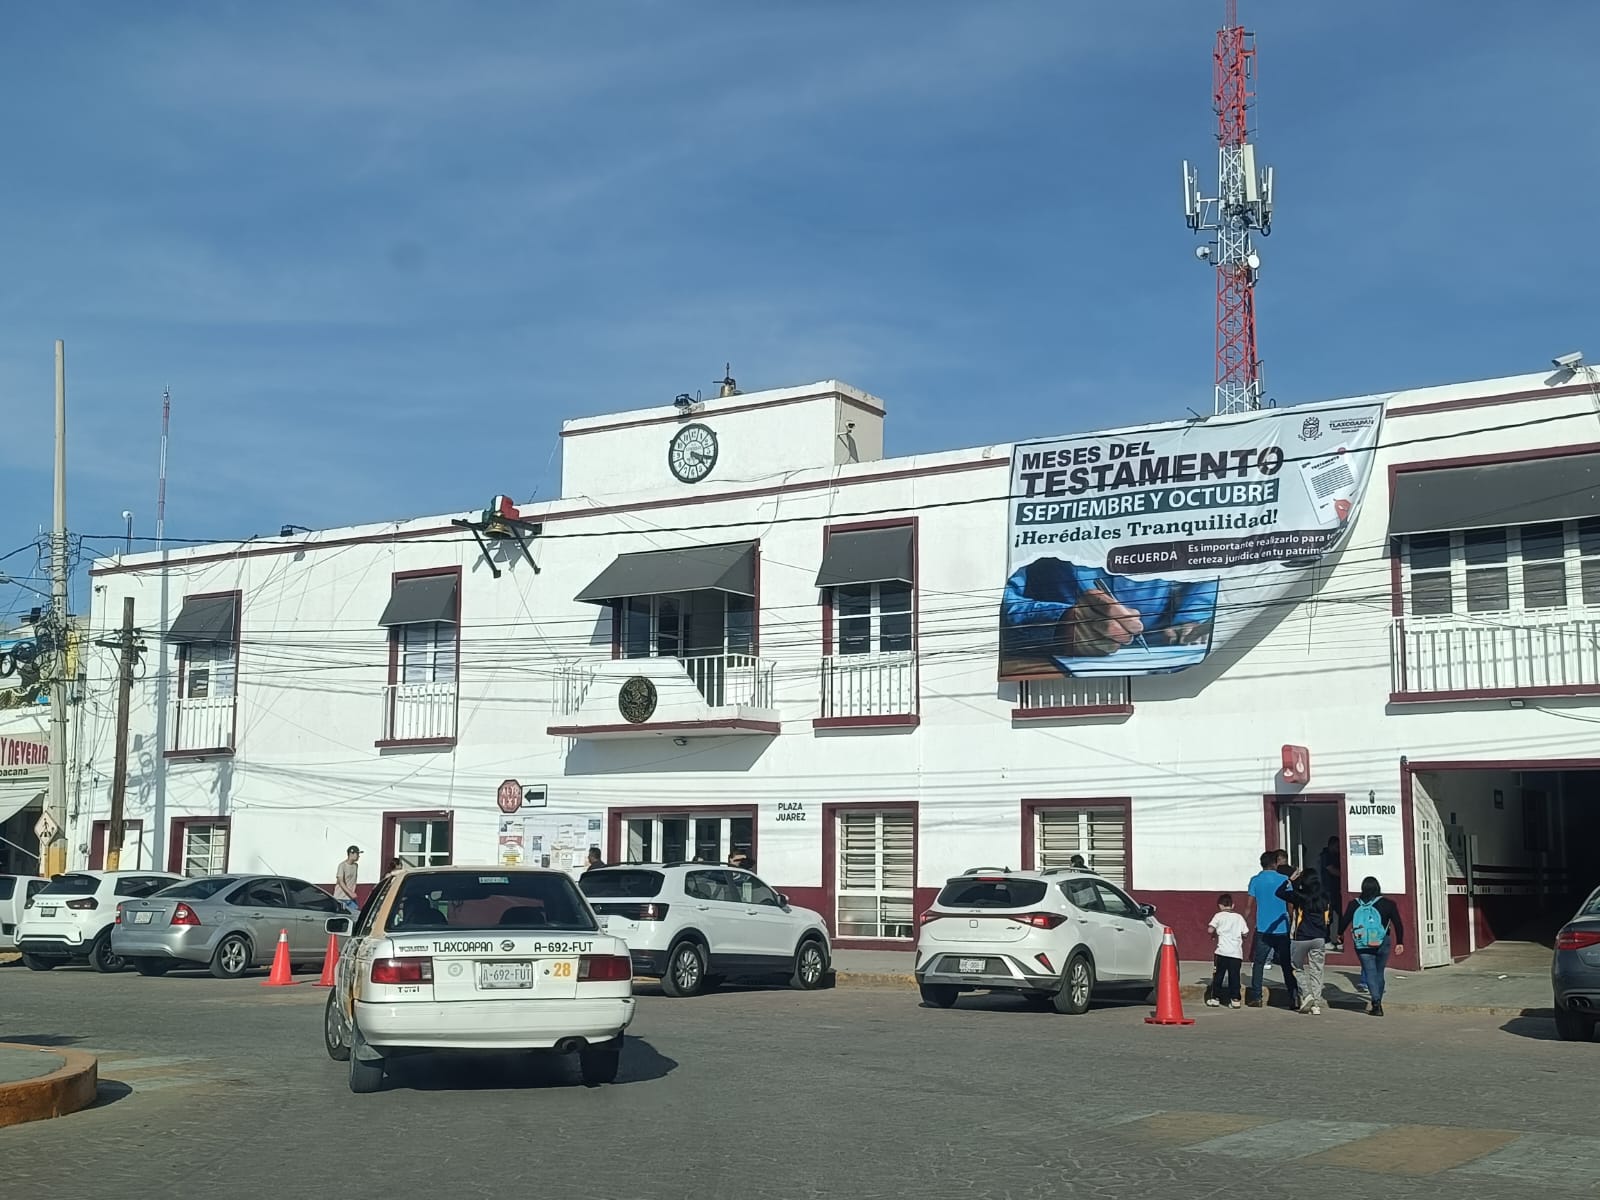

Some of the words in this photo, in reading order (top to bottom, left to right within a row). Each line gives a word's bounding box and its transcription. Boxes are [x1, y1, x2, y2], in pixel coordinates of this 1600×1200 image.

[1021, 446, 1101, 471] MESES
[1109, 441, 1155, 460] DEL
[1020, 446, 1284, 498] TESTAMENTO
[1022, 493, 1145, 521] SEPTIEMBRE
[1150, 491, 1164, 510] Y
[1168, 482, 1274, 508] OCTUBRE
[1015, 526, 1121, 547] ¡Herédales
[1127, 509, 1278, 537] Tranquilidad!
[1188, 544, 1199, 553] Es
[1200, 540, 1254, 553] importante
[1256, 534, 1299, 546] realizarlo
[1301, 535, 1325, 545] para
[1114, 550, 1178, 564] RECUERDA
[1187, 555, 1223, 565] certeza
[1261, 549, 1271, 558] en
[1272, 547, 1283, 556] tu
[1, 737, 7, 766] Y
[8, 738, 49, 766] NEVERIA
[778, 802, 803, 811] PLAZA
[1349, 805, 1396, 815] AUDITORIO
[775, 812, 806, 821] JUAREZ
[433, 941, 494, 953] TLAXCOAPAN
[534, 941, 593, 952] A-692-FUT
[483, 968, 531, 981] A-692-FUT
[553, 962, 571, 977] 28
